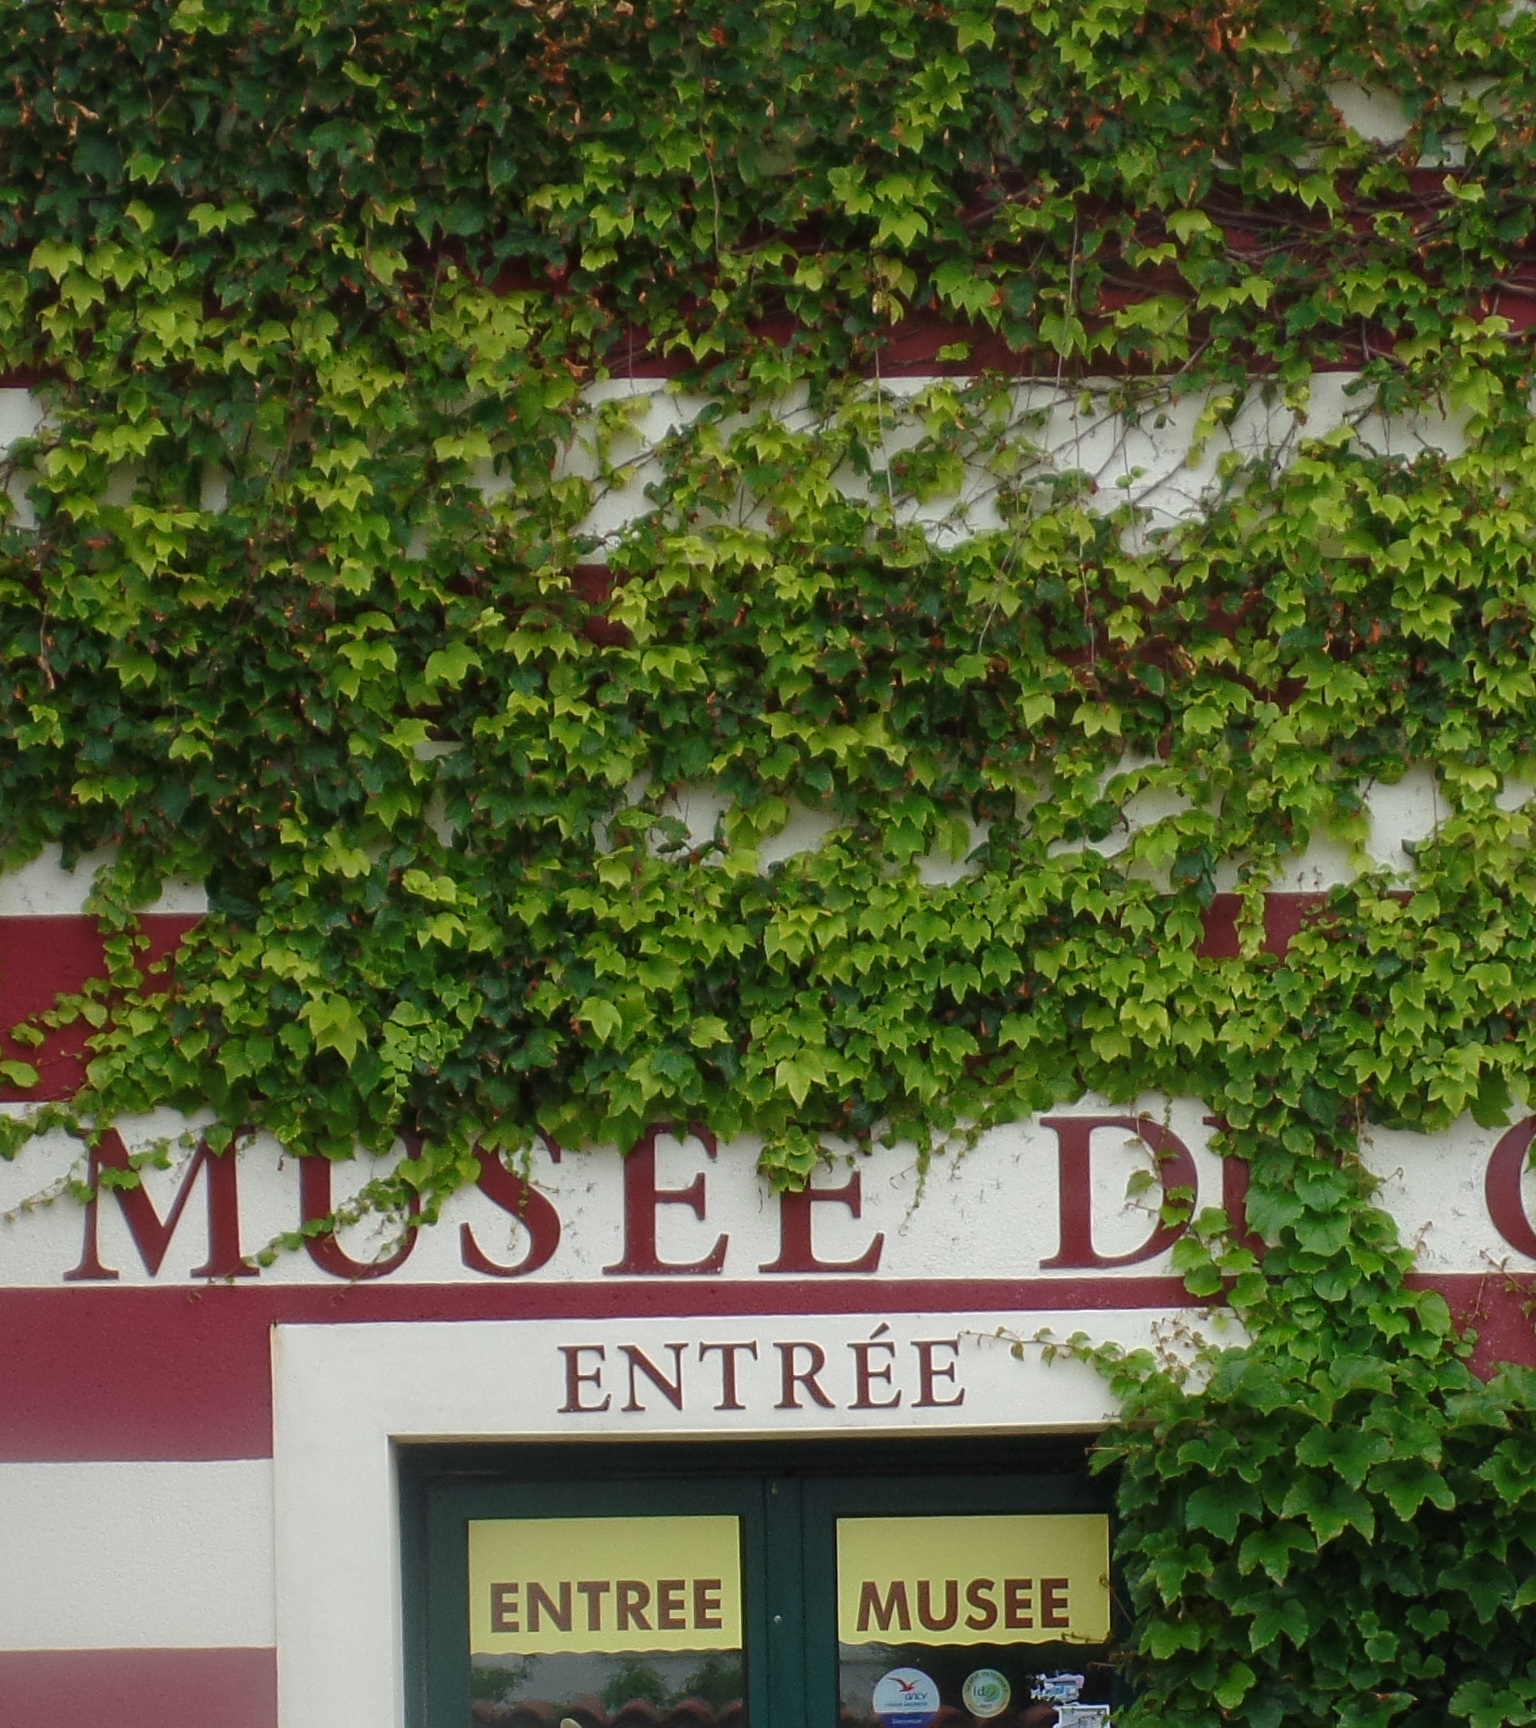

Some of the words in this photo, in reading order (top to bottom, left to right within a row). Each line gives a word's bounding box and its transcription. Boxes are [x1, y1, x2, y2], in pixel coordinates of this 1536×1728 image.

[557, 1322, 967, 1414] ENTRÉE
[489, 1577, 724, 1634] ENTREE
[856, 1576, 1071, 1633] MUSEE
